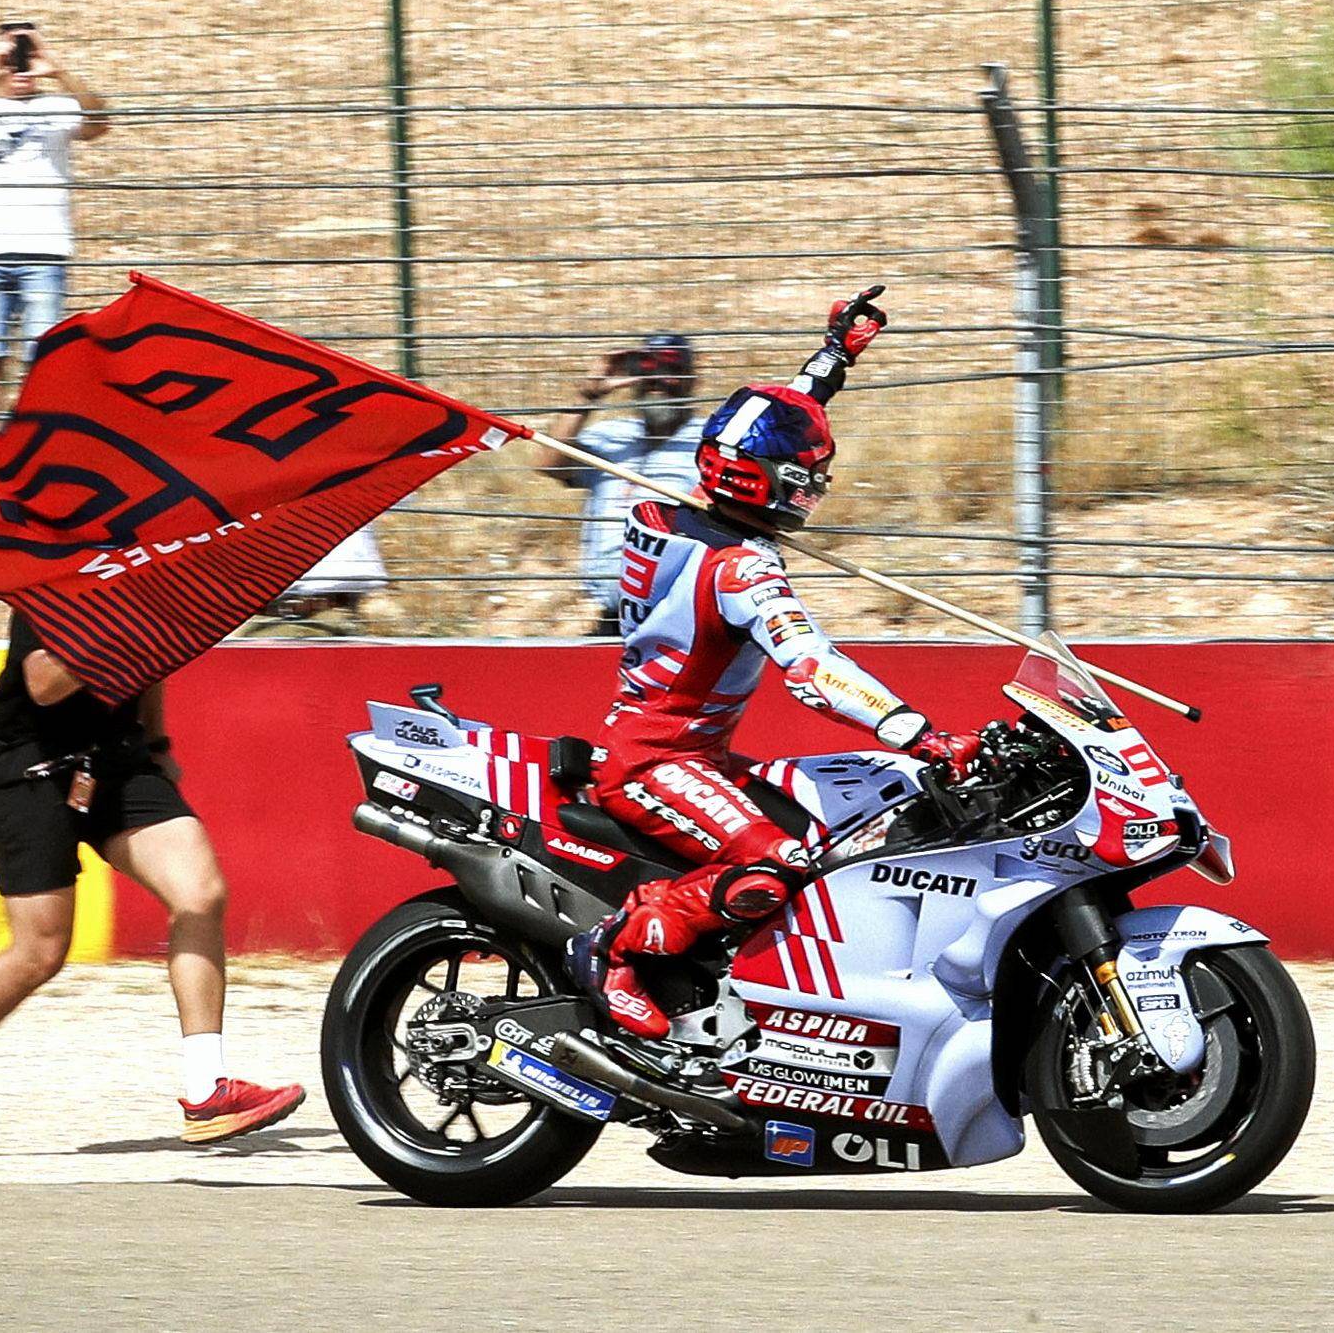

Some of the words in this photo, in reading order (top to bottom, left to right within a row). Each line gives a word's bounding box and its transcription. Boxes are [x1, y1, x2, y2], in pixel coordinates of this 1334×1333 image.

[652, 763, 750, 835] DUCATI
[870, 863, 978, 898] DUCATI
[522, 1065, 602, 1108] MICHELIN
[772, 1067, 822, 1086] GLOW
[733, 1077, 855, 1118] FEDERAL
[863, 1101, 910, 1125] OIL
